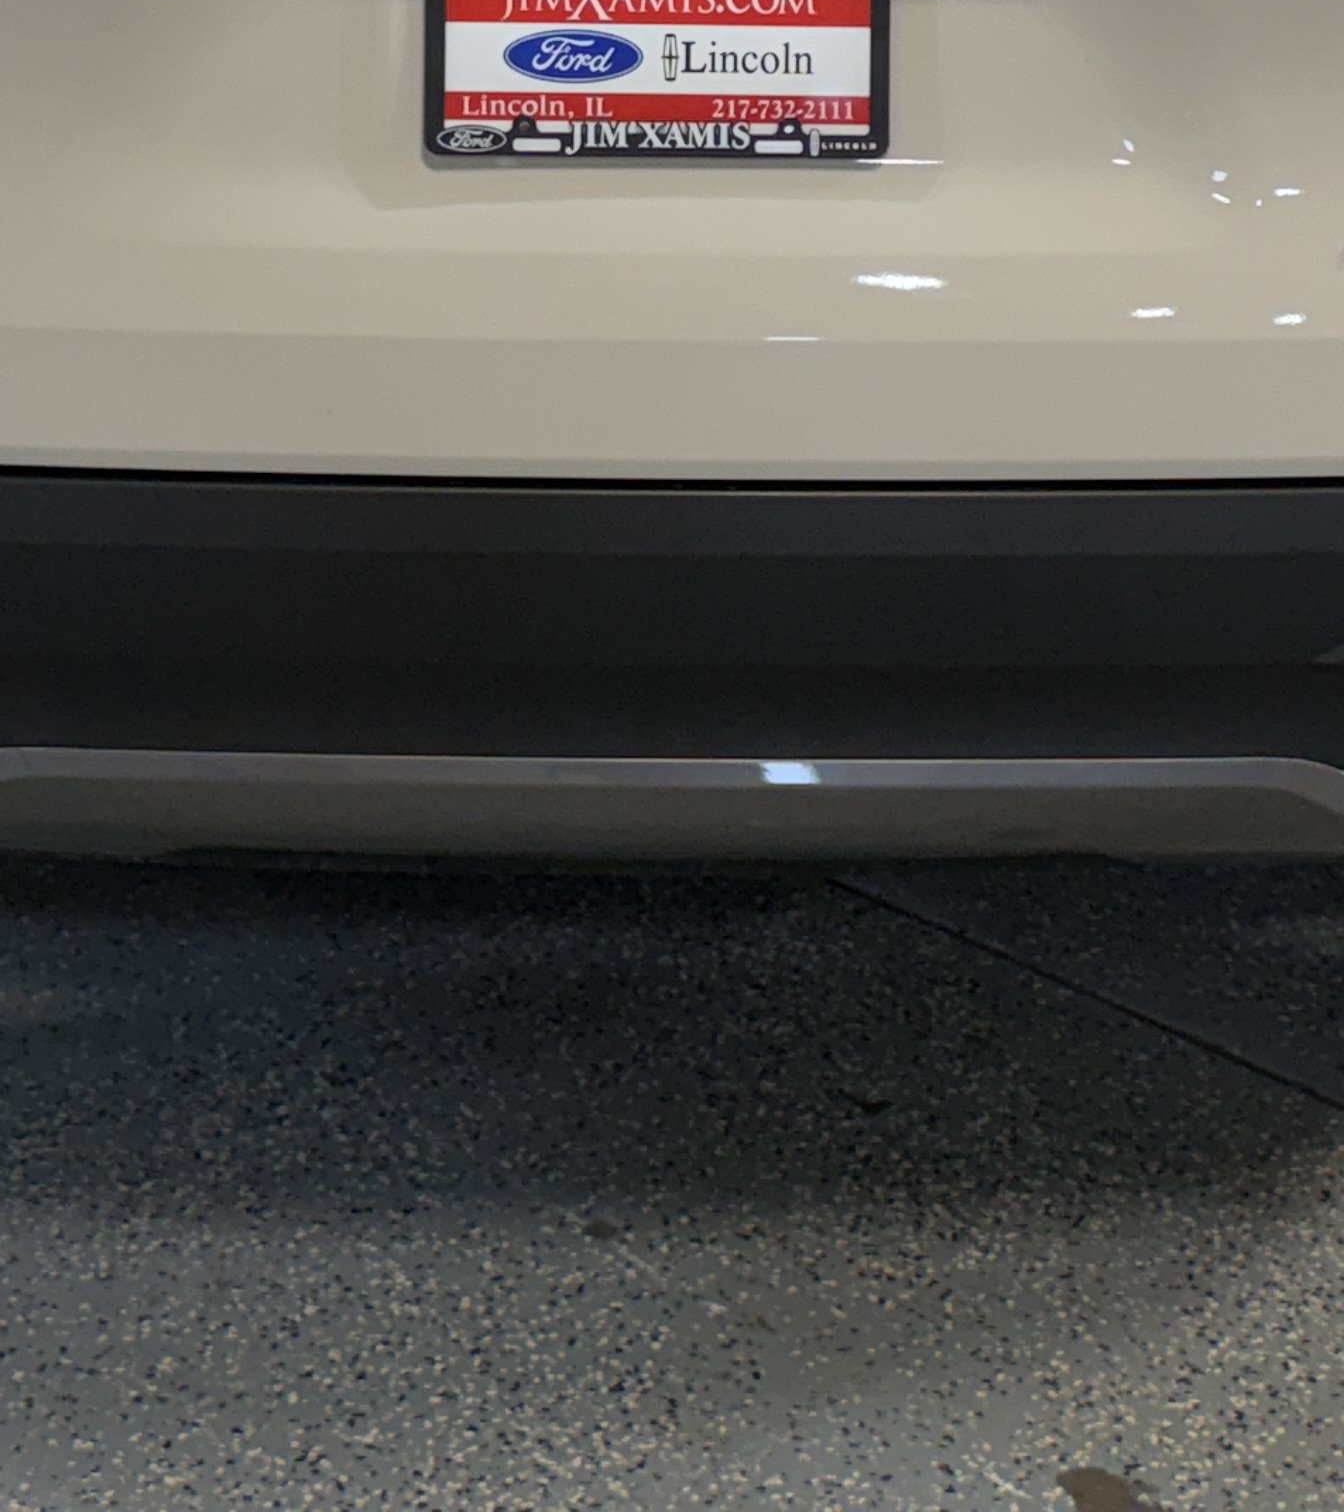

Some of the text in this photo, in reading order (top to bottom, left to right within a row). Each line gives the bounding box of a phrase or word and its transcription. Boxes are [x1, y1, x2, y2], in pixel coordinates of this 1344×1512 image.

[532, 36, 614, 73] Ford
[681, 41, 814, 75] Lincoln
[462, 94, 613, 118] Lincoln, IL
[712, 99, 854, 120] 217-732-2111
[565, 120, 751, 155] JIM XAMIS
